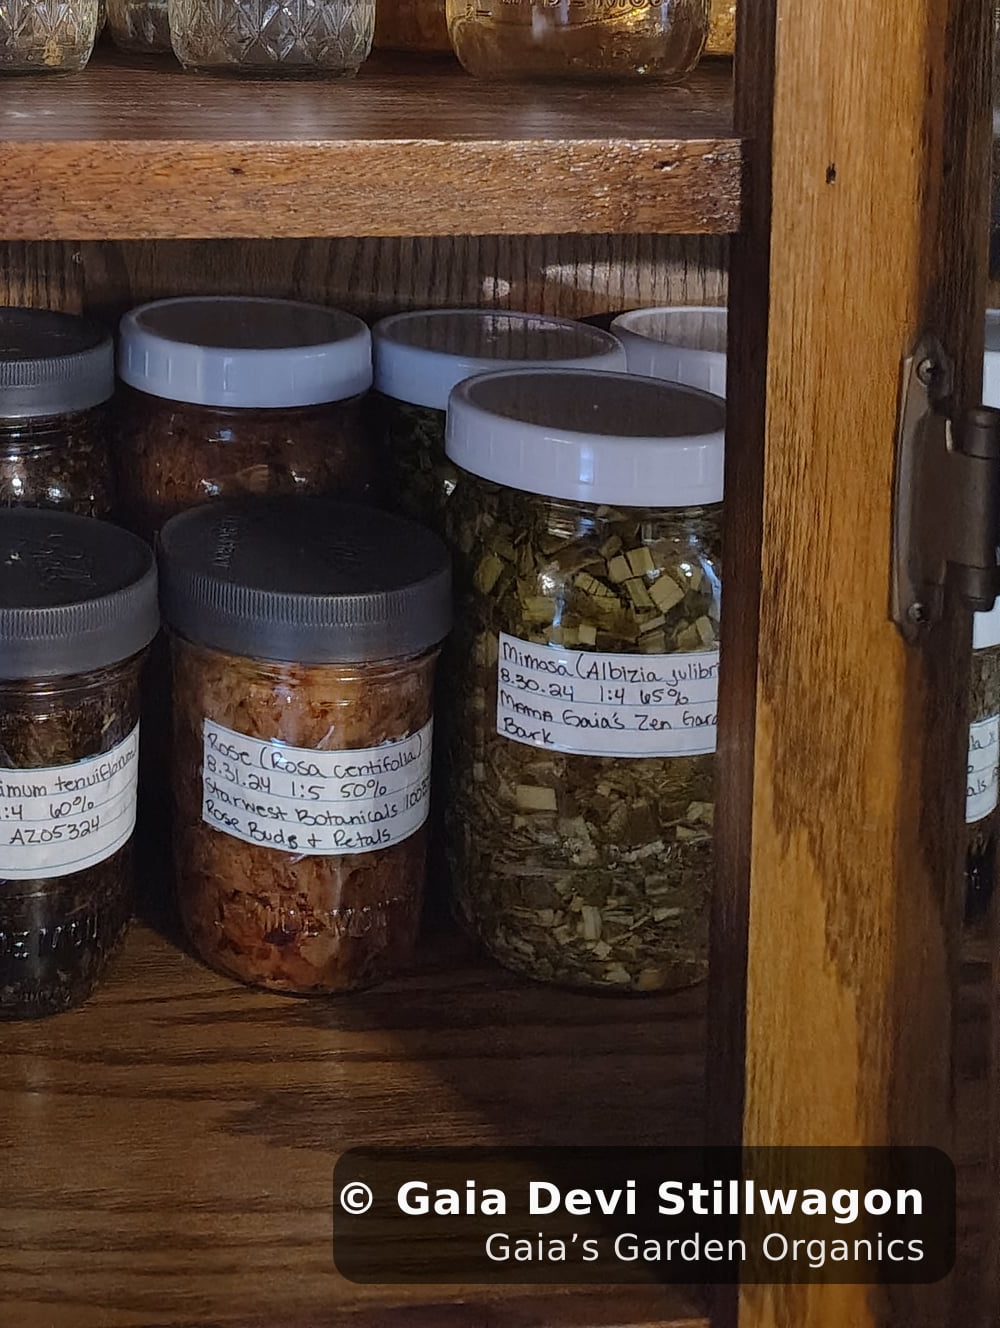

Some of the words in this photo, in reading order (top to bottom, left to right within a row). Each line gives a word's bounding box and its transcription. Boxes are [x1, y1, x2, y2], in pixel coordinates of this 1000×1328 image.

[500, 667, 574, 703] 8.30.24
[600, 685, 625, 705] 1:4
[640, 688, 689, 706] 65%
[503, 641, 574, 677] Mimosa
[576, 653, 663, 684] (Albizia
[666, 662, 720, 687] julibr
[503, 717, 555, 744] Bark
[563, 709, 625, 730] Gaia's
[634, 713, 673, 731] Zen
[206, 754, 271, 794] 8.31.24
[291, 781, 326, 800] 1:5
[340, 778, 387, 799] 50%
[207, 732, 253, 766] Rose
[259, 746, 328, 779] (Rosa
[49, 795, 95, 819] 60%
[205, 777, 288, 821] Starwest
[295, 802, 399, 827] Botanicals
[205, 799, 242, 833] Rose
[333, 828, 391, 848] Petals
